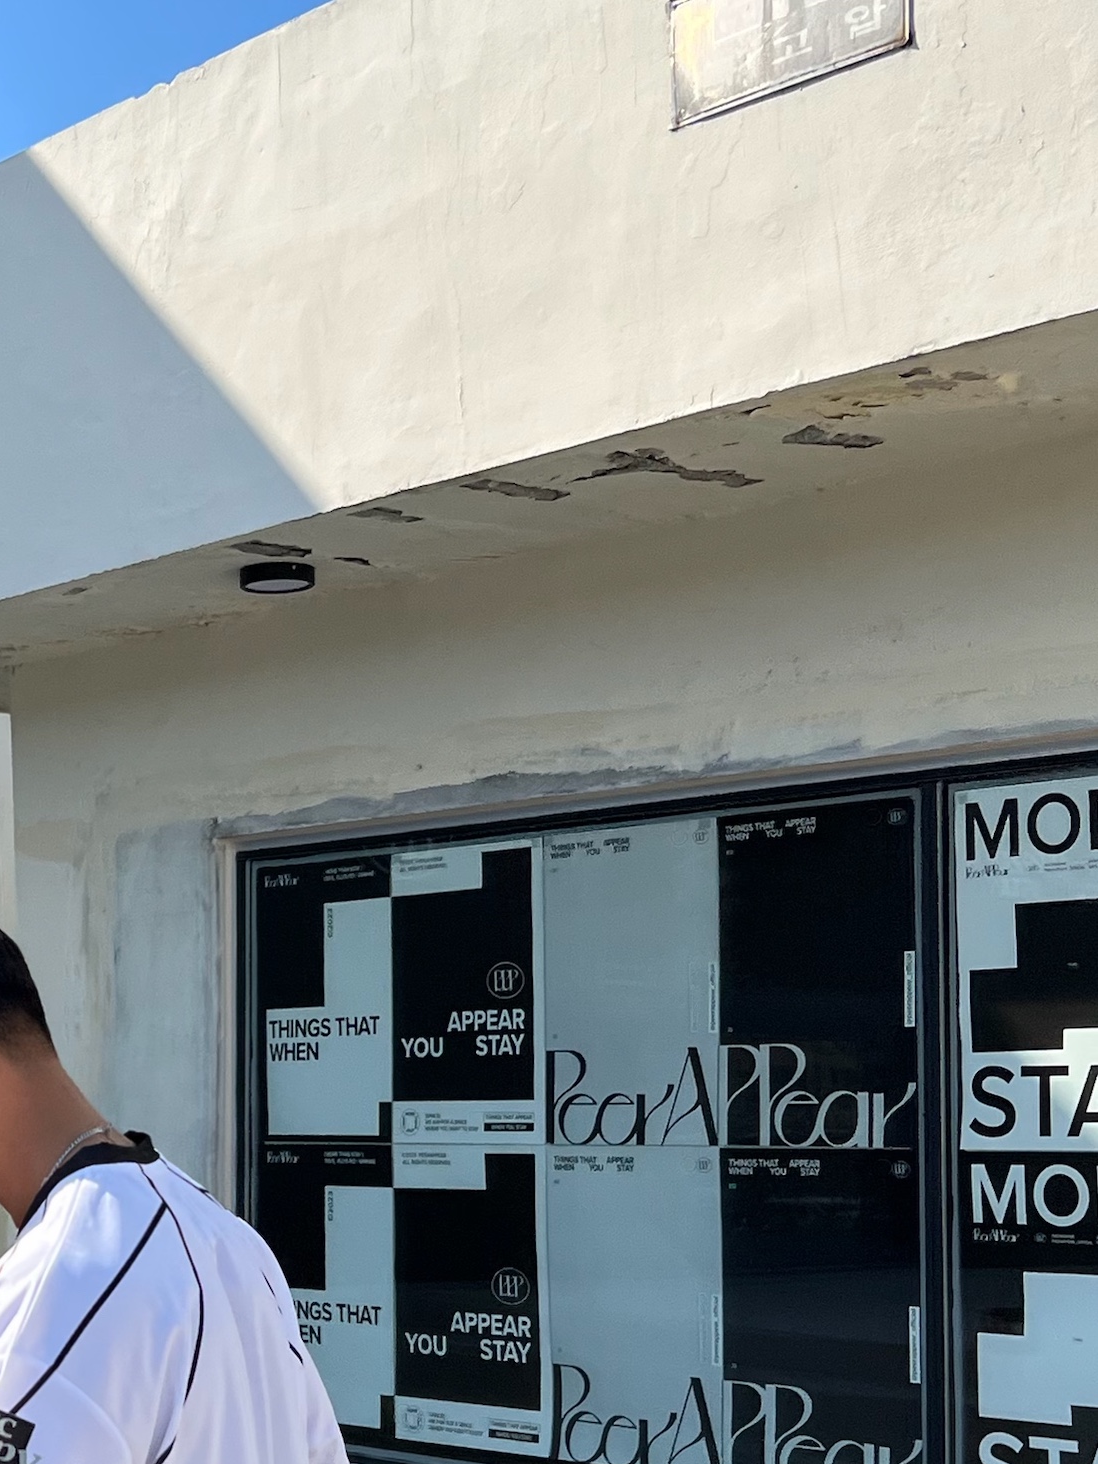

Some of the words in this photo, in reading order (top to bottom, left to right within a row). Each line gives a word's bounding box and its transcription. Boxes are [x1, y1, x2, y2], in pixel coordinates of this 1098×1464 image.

[765, 828, 783, 838] YOU
[796, 825, 816, 835] STAY
[785, 816, 816, 827] APPEAR
[965, 788, 1098, 861] MO
[269, 1018, 331, 1038] THINGS
[335, 1015, 380, 1036] THAT
[447, 1008, 525, 1032] APPEAR
[269, 1041, 319, 1062] WHEN
[401, 1037, 443, 1058] YOU
[475, 1033, 525, 1056] STAY
[553, 1155, 579, 1164] THINGS
[579, 1155, 597, 1164] THAT
[589, 1164, 604, 1173] YOU
[616, 1164, 634, 1172] STAY
[728, 1158, 758, 1167] THINGS
[758, 1158, 779, 1168] THAT
[789, 1159, 820, 1168] APPEAR
[728, 1167, 753, 1176] WHEN
[769, 1167, 787, 1176] YOU
[800, 1168, 820, 1177] STAY
[970, 1163, 1098, 1227] MO
[336, 1303, 381, 1326] THAT
[450, 1311, 532, 1338] APPEAR
[405, 1332, 447, 1357] YOU
[480, 1338, 532, 1364] STAY
